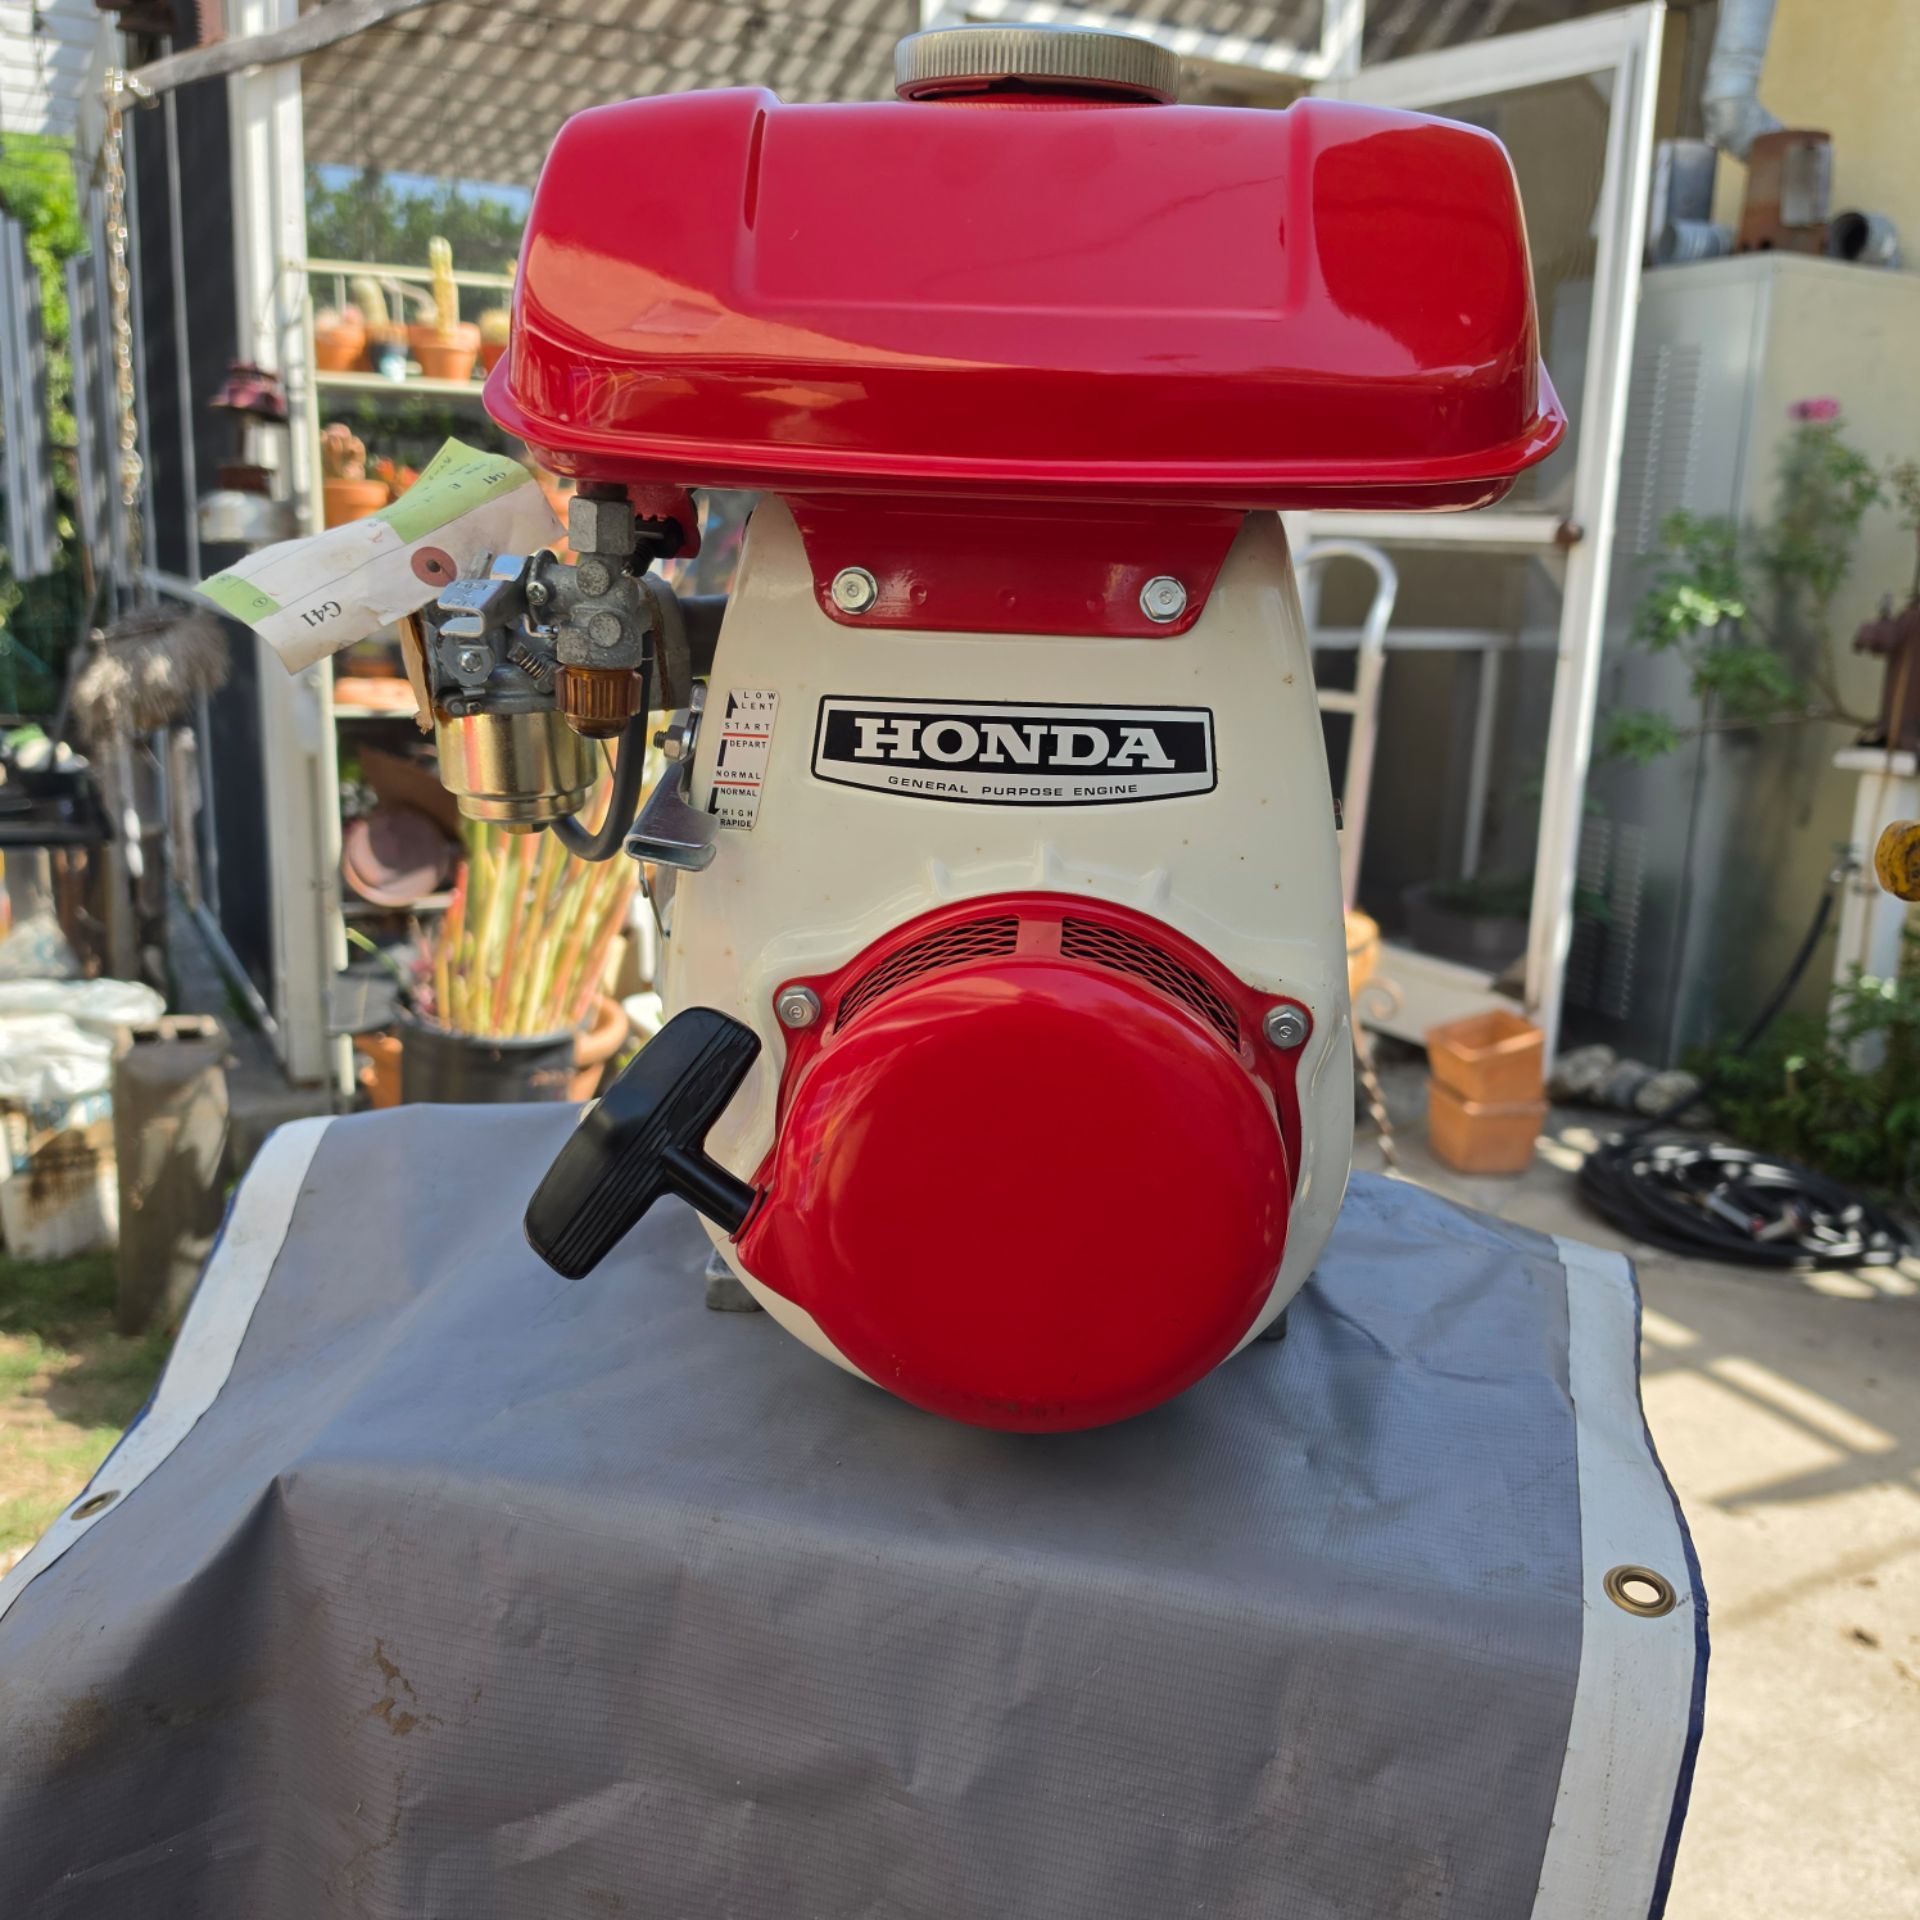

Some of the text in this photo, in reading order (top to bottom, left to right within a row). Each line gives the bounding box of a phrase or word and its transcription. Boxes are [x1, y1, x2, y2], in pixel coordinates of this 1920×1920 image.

[300, 601, 342, 627] G41
[743, 691, 776, 700] LOW
[741, 702, 774, 711] LENT
[724, 722, 770, 731] START
[729, 740, 767, 749] DEPART
[854, 716, 1175, 769] HONDA
[716, 770, 761, 780] NORMAL
[887, 775, 1138, 797] GENERAL PURPOSE ENGINE
[720, 787, 757, 797] NORMAL
[721, 808, 753, 817] HIGH
[719, 818, 753, 828] RAPIDE
